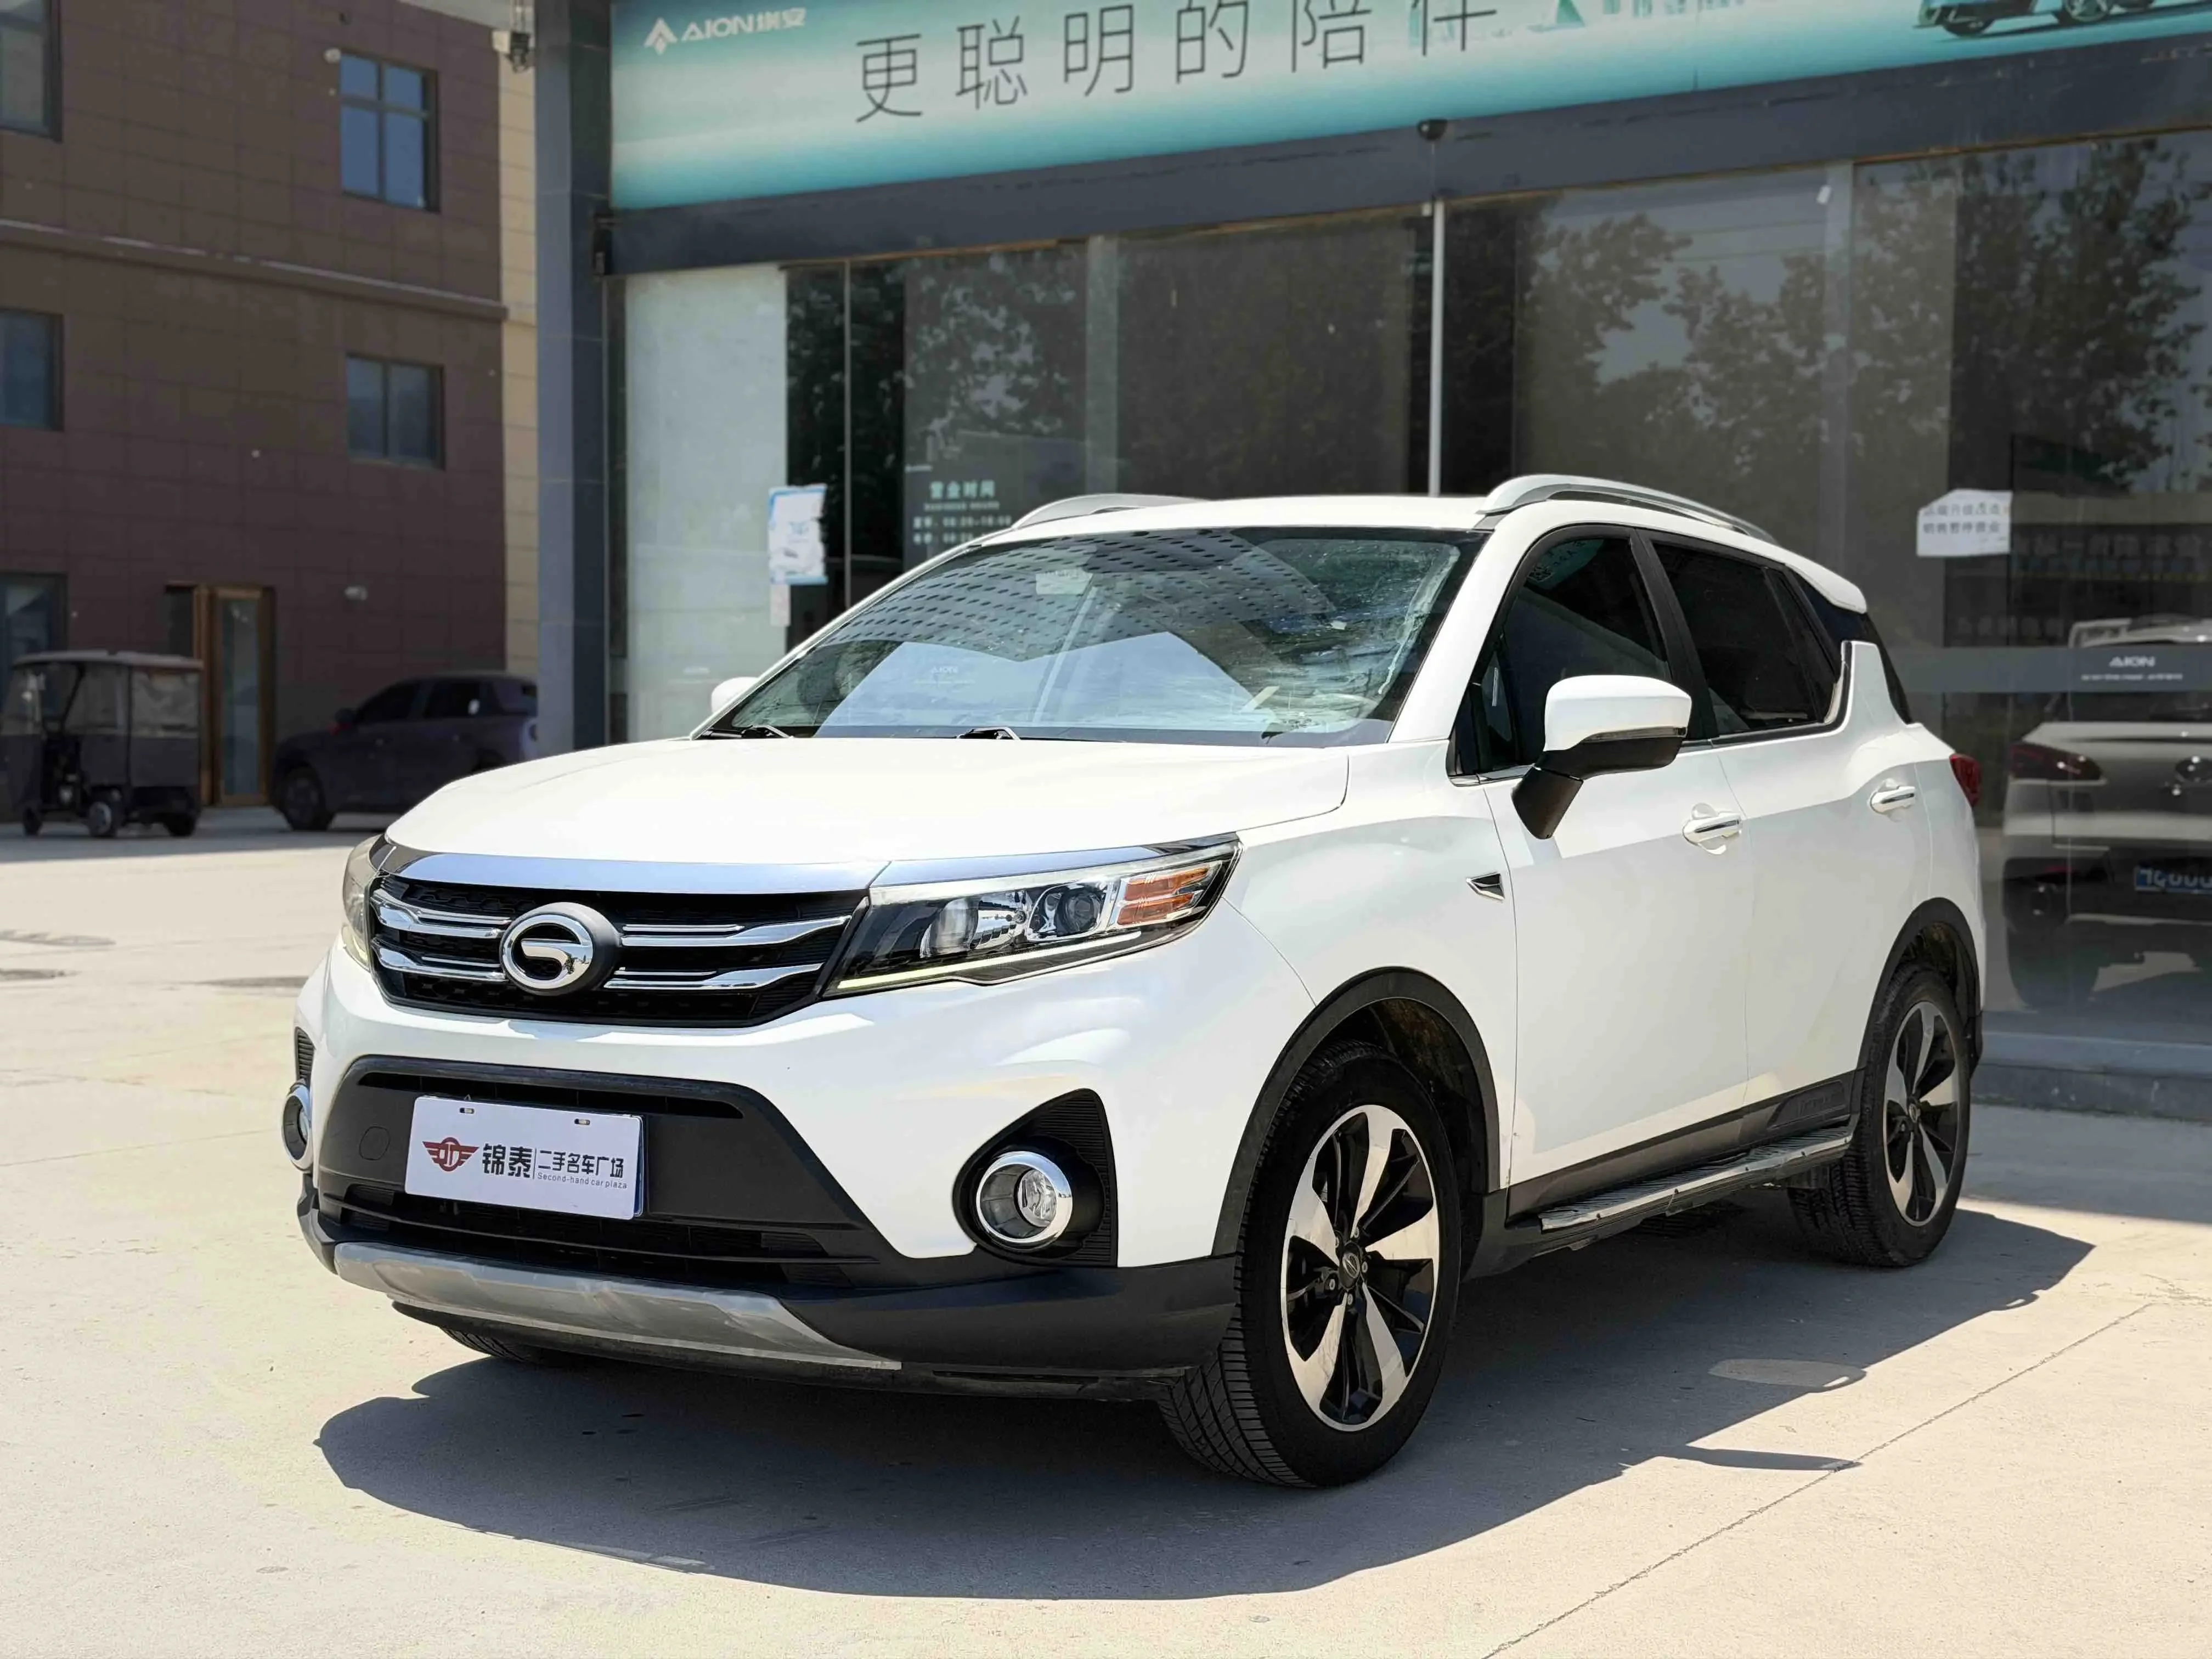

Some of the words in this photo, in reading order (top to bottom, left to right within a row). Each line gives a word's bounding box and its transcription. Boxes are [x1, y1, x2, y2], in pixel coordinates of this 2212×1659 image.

[2108, 656, 2156, 668] AION
[482, 1143, 533, 1178] 锦泰
[538, 1150, 624, 1179] 二手名车广场
[537, 1172, 589, 1186] Second-hand
[590, 1178, 604, 1187] car
[605, 1179, 628, 1189] plaza
